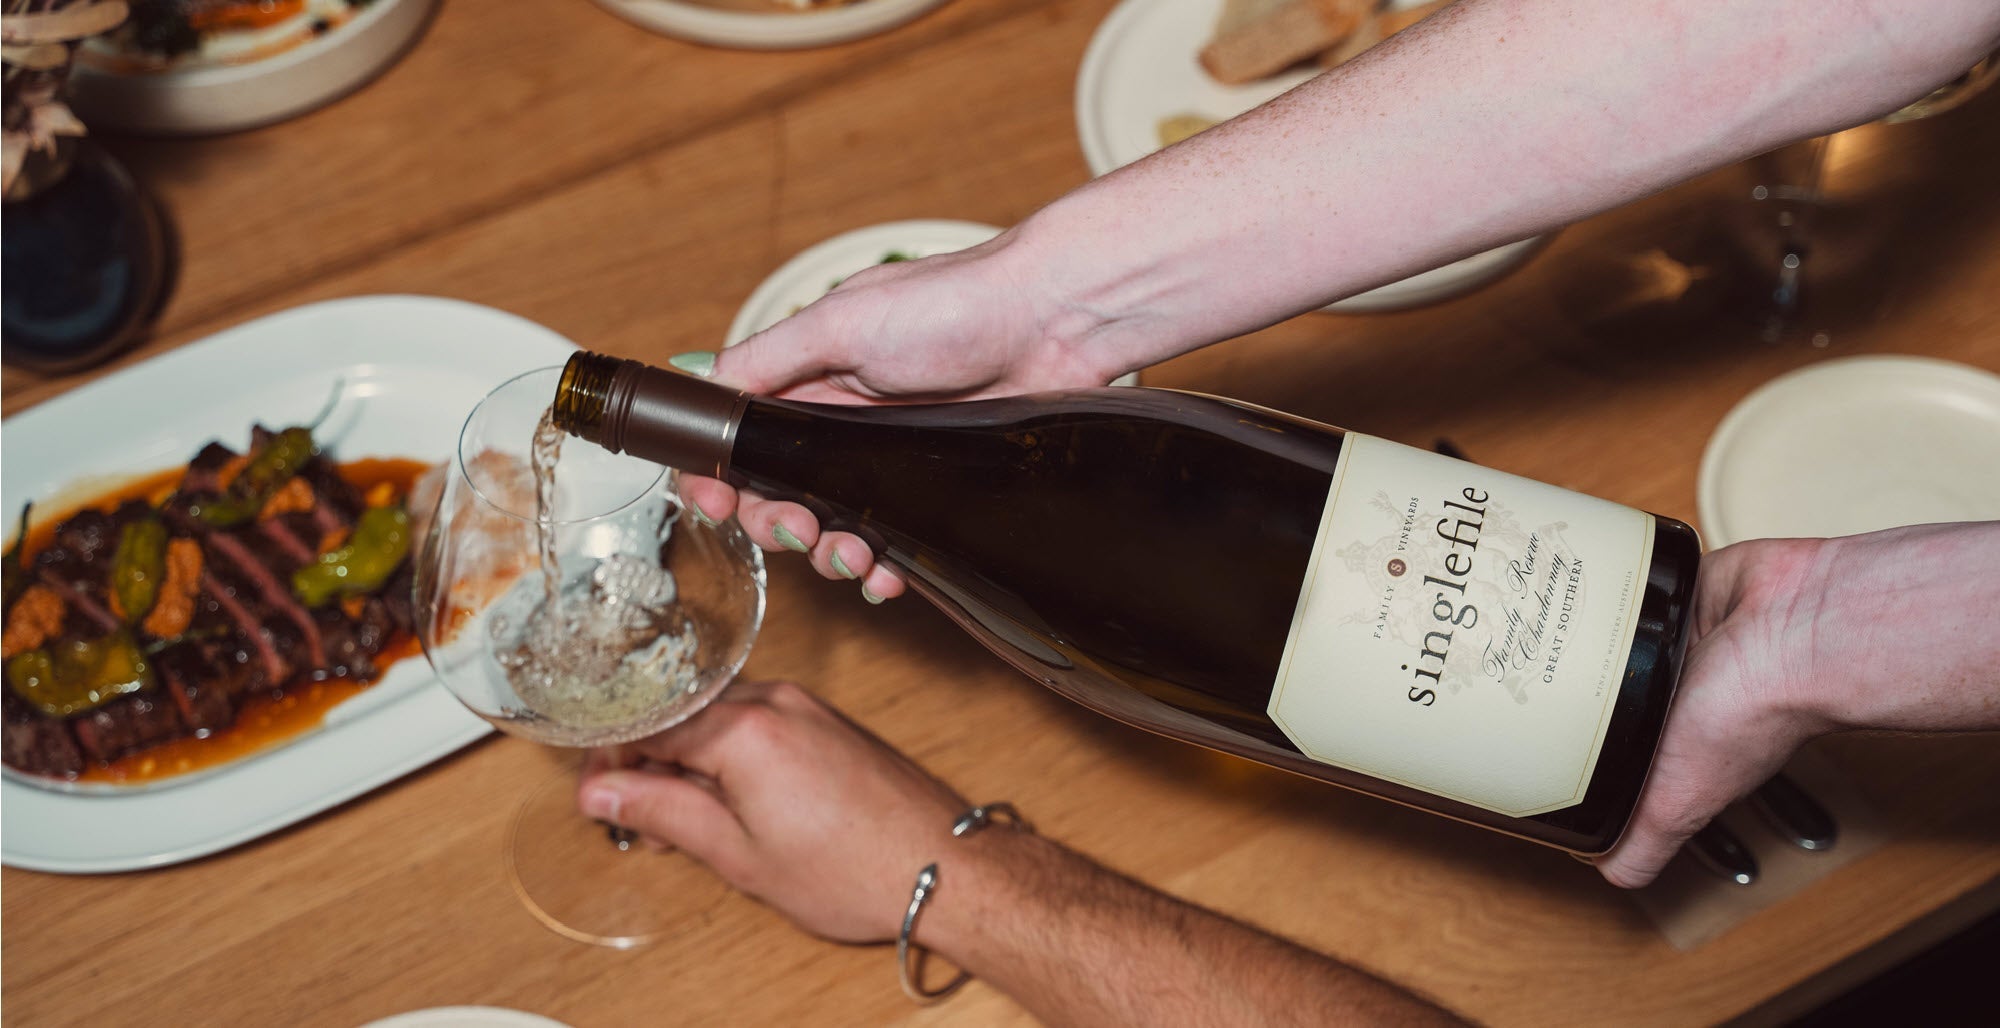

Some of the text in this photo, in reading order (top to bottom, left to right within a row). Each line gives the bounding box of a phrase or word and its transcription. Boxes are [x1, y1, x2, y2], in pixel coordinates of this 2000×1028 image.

[1373, 585, 1395, 639] FAMILY
[1398, 496, 1419, 551] VINEYARDS
[1401, 486, 1489, 707] singlefile
[1482, 532, 1540, 683] Family Reserve
[1512, 554, 1570, 670] Chardonnay
[1543, 558, 1584, 684] GREAT SOUTHERN
[1595, 675, 1606, 697] WINE
[1607, 615, 1622, 655] WESTERN
[1619, 570, 1633, 613] AUSTRALIA
